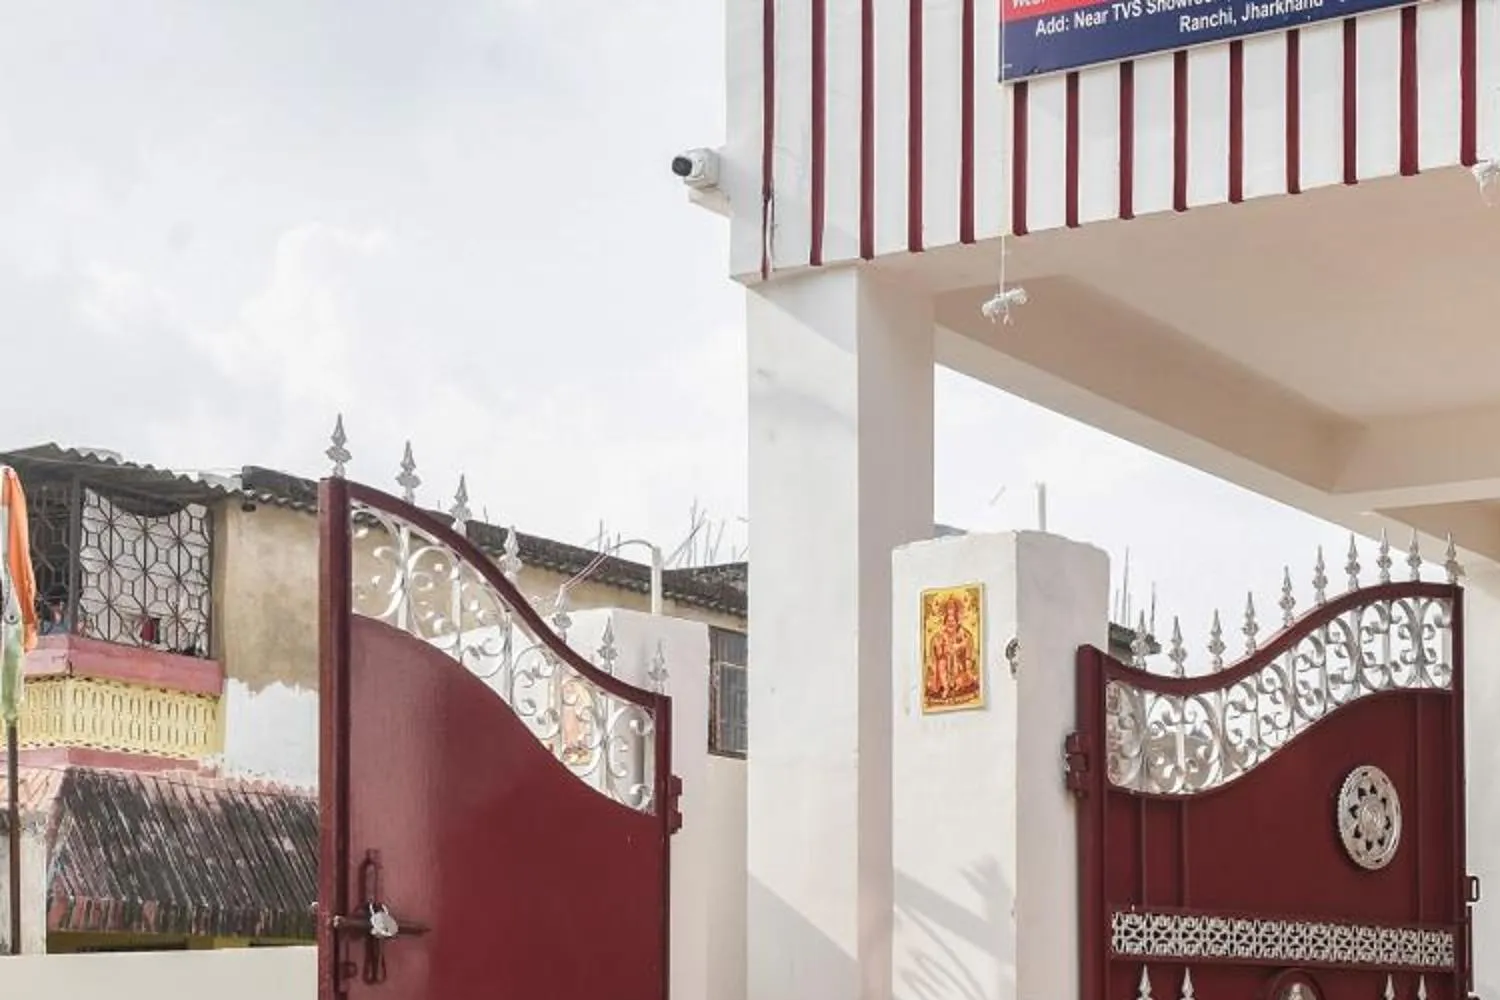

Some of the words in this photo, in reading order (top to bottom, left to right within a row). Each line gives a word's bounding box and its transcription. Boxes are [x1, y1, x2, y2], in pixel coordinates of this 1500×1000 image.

[1035, 18, 1070, 37] Add:
[1073, 9, 1109, 29] Near
[1112, 1, 1142, 21] TVS
[1179, 7, 1237, 33] Ranchi,
